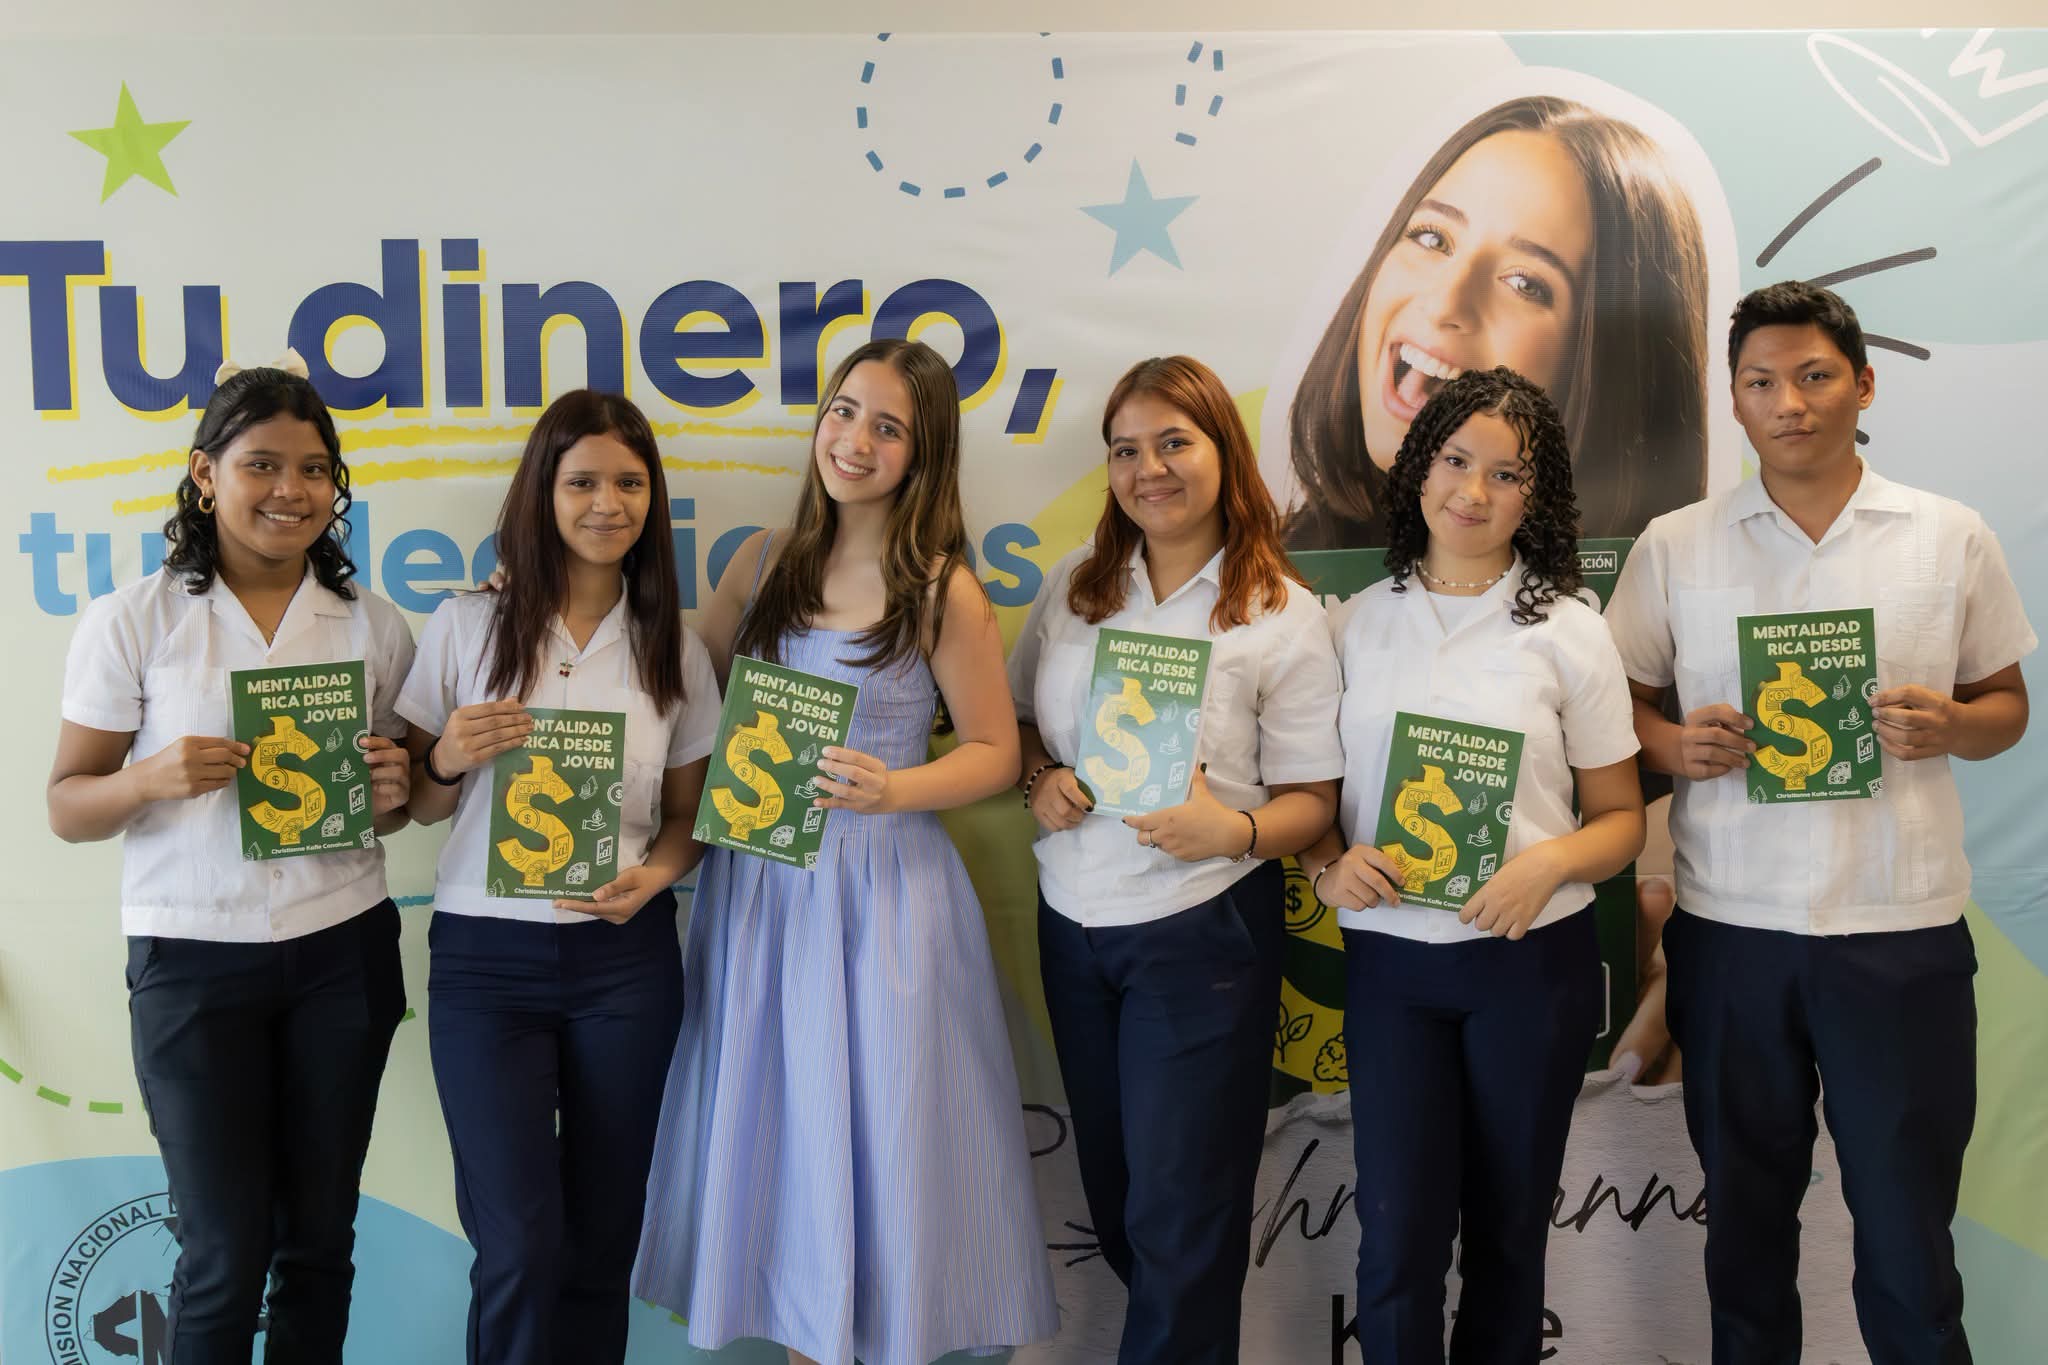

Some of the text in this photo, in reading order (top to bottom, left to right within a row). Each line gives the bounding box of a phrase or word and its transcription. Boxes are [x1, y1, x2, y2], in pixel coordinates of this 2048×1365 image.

[0, 238, 1057, 434] Tu dinero,
[1753, 620, 1861, 640] MENTALIDAD
[1108, 639, 1199, 662] MENTALIDAD
[1767, 638, 1862, 656] RICA DESDE
[1117, 658, 1197, 679] RICA DESDE
[1810, 654, 1866, 671] JOVEN
[247, 673, 351, 694] MENTALIDAD
[744, 669, 843, 706] MENTALIDAD
[1149, 679, 1197, 696] JOVEN
[261, 690, 353, 711] RICA DESDE
[752, 689, 840, 724] RICA DESDE
[303, 707, 357, 724] JOVEN
[530, 719, 613, 736] NTALIDAD
[786, 717, 839, 741] JOVEN
[523, 735, 612, 753] RICA DESDE
[1408, 724, 1509, 754] MENTALIDAD
[561, 755, 615, 770] JOVEN
[1417, 744, 1507, 771] RICA DESDE
[1453, 769, 1508, 788] JOVEN
[59, 1202, 162, 1289] NACIONAL
